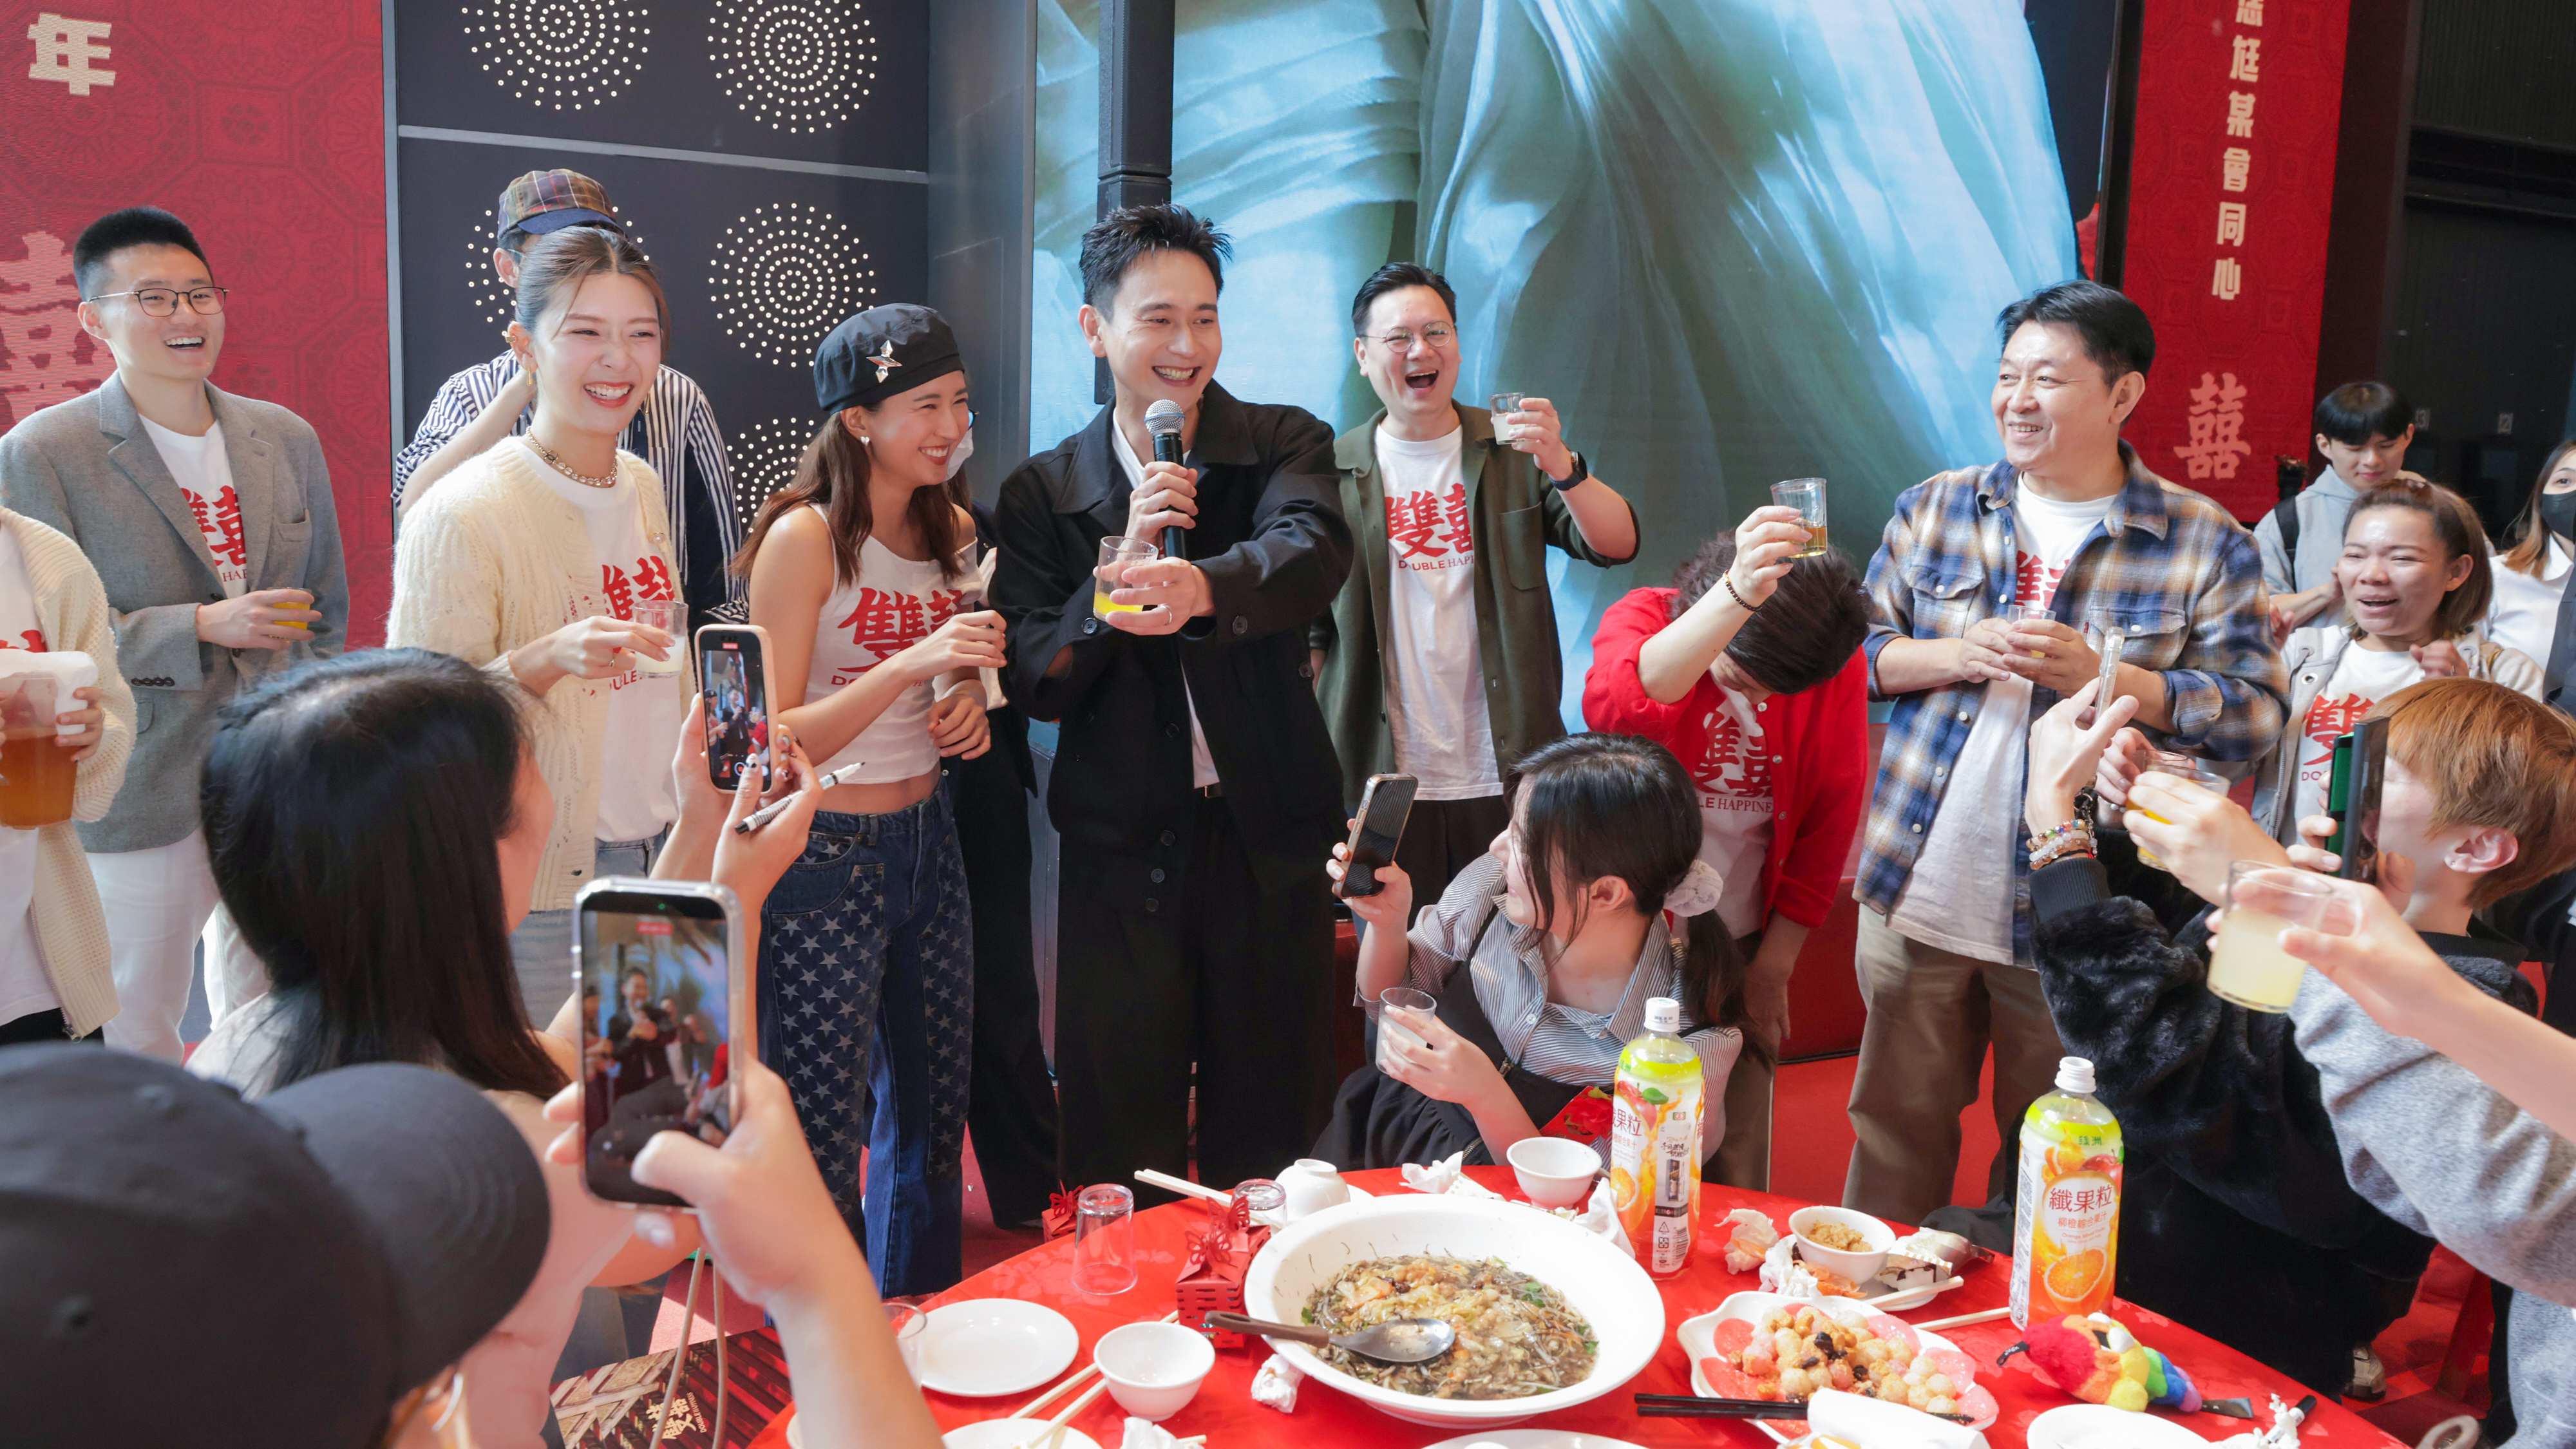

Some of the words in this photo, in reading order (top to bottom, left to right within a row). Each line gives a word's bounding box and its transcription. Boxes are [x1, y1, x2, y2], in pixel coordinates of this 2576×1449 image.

[27, 13, 116, 96] 年
[2174, 372, 2251, 480] 囍
[837, 587, 965, 672] 雙
[1718, 798, 1773, 813] HAPPINE
[2049, 1184, 2113, 1214] 纖果粒
[2058, 1211, 2107, 1229] 柳橙綜合果汁
[694, 1412, 707, 1433] DOUBLE
